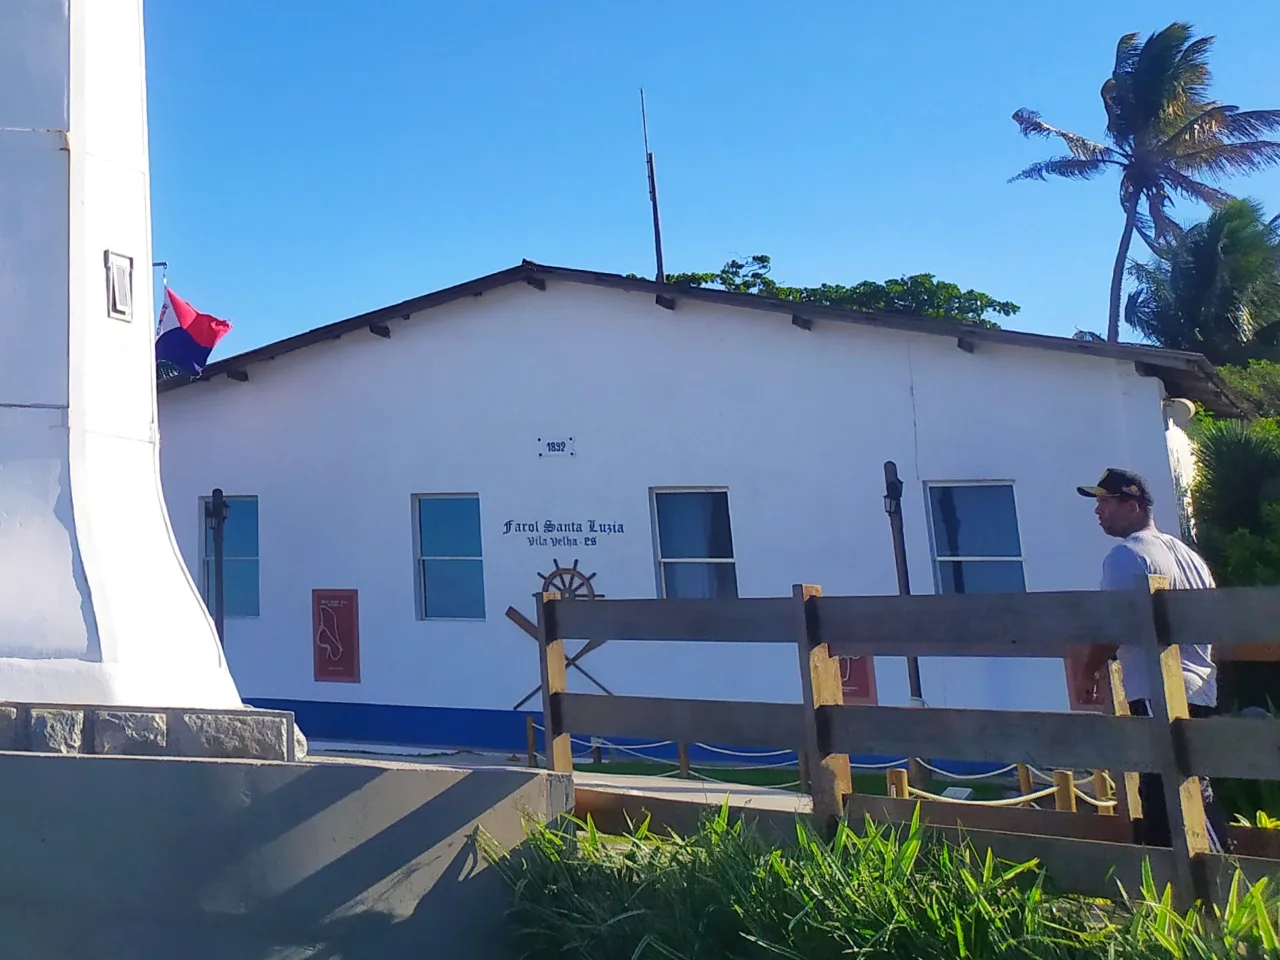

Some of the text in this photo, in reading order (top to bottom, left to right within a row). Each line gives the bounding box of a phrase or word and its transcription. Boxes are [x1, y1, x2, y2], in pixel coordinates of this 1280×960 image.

[545, 441, 566, 452] 1892
[502, 519, 624, 535] Farol Santa Luzia
[527, 536, 548, 547] Vila
[549, 536, 578, 548] Velha
